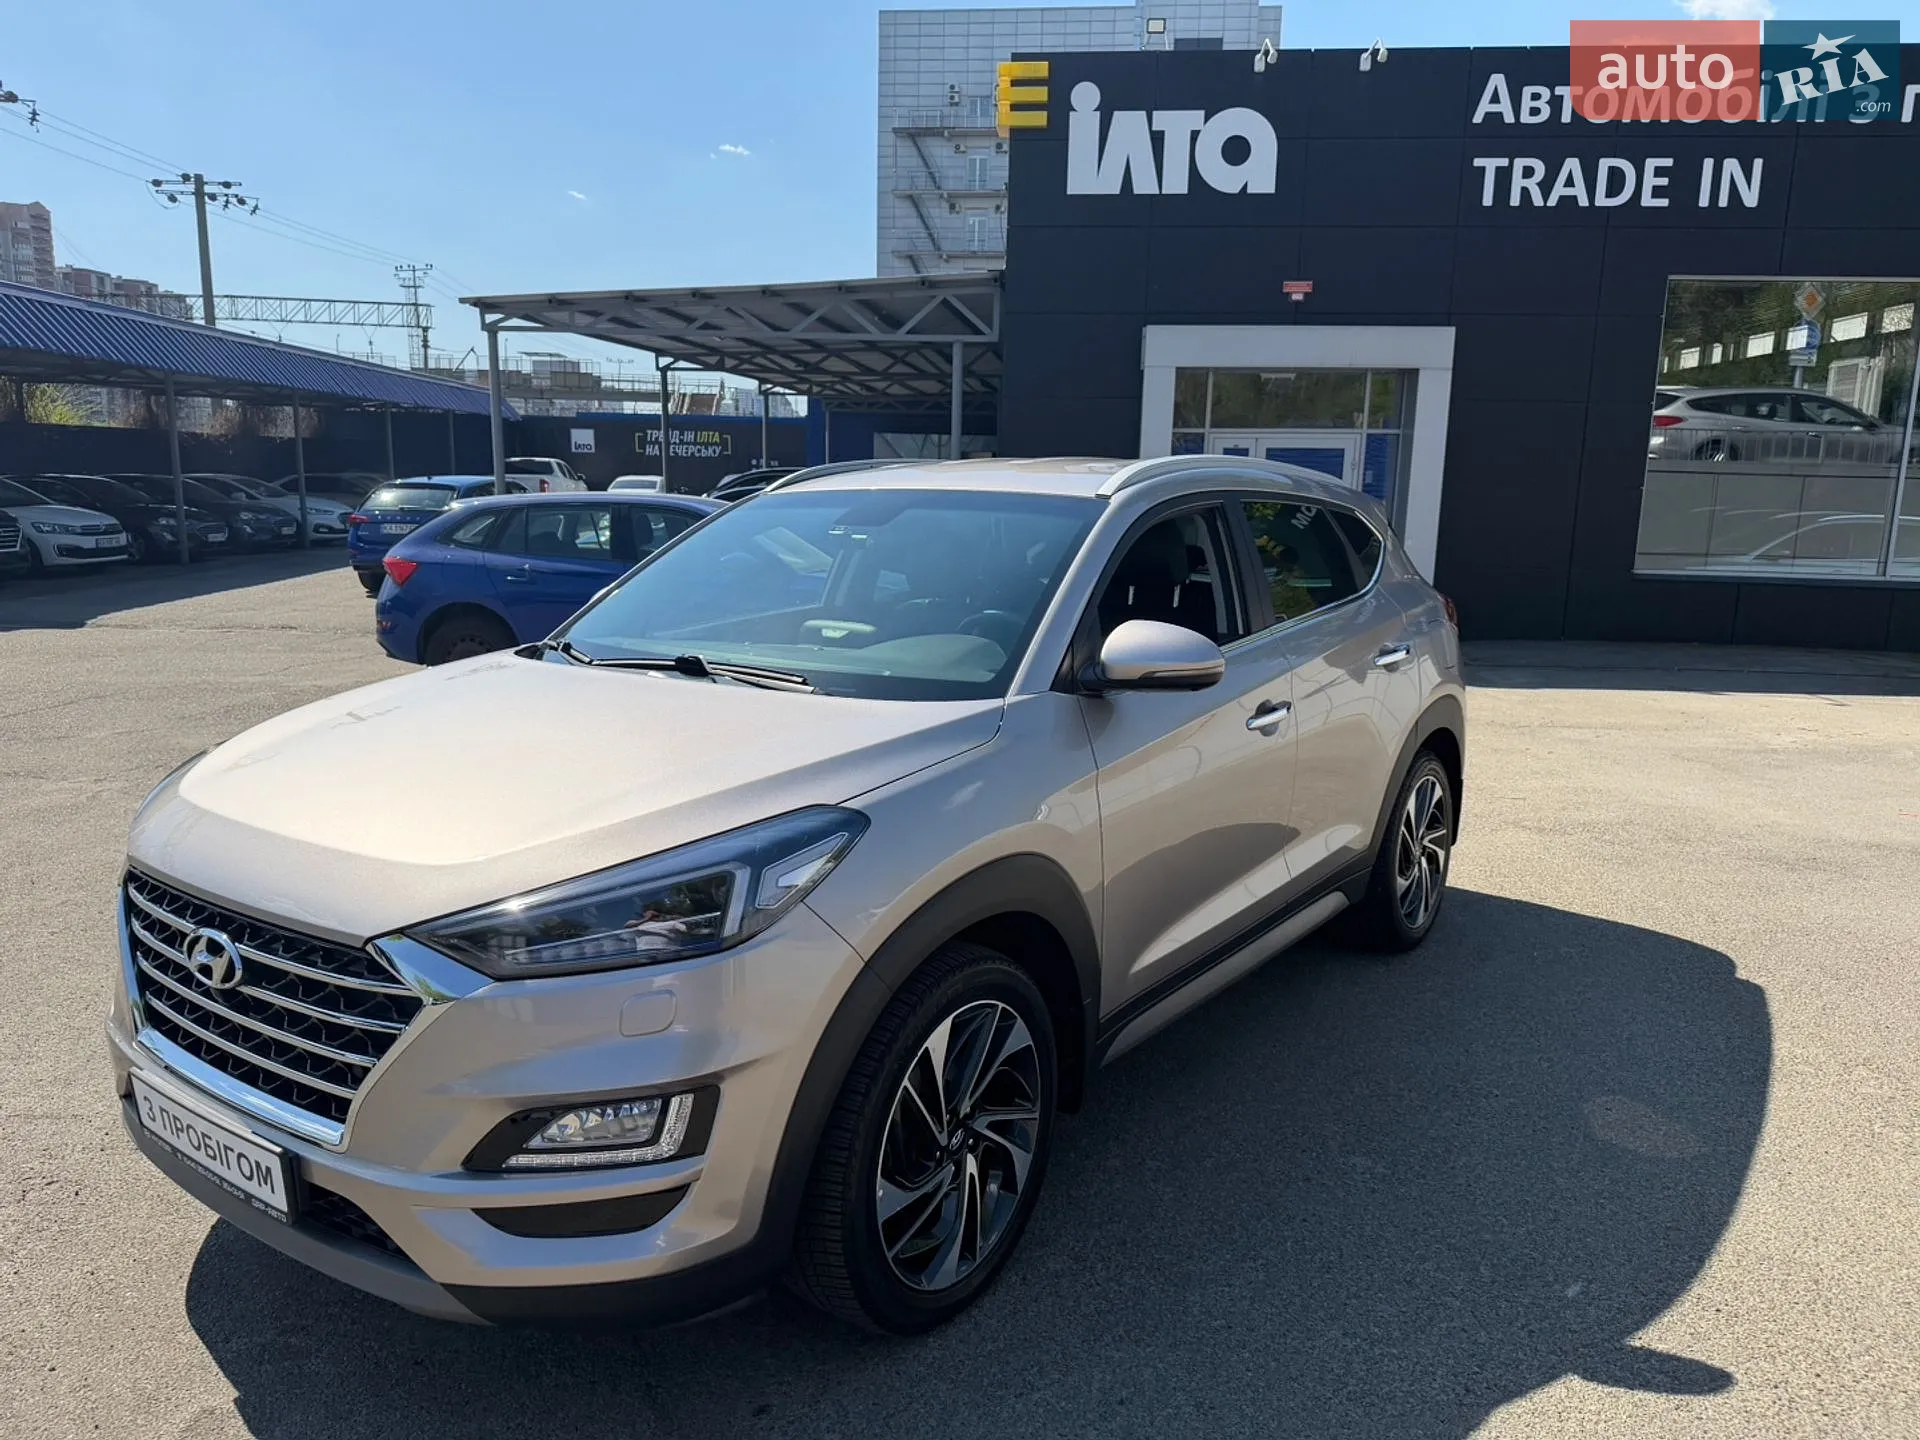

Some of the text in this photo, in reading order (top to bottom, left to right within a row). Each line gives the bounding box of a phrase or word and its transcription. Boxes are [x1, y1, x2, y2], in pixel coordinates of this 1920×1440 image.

[1473, 157, 1764, 208] TRADE IN
[646, 445, 660, 455] НА
[159, 1105, 275, 1194] ПРОБІГОМ
